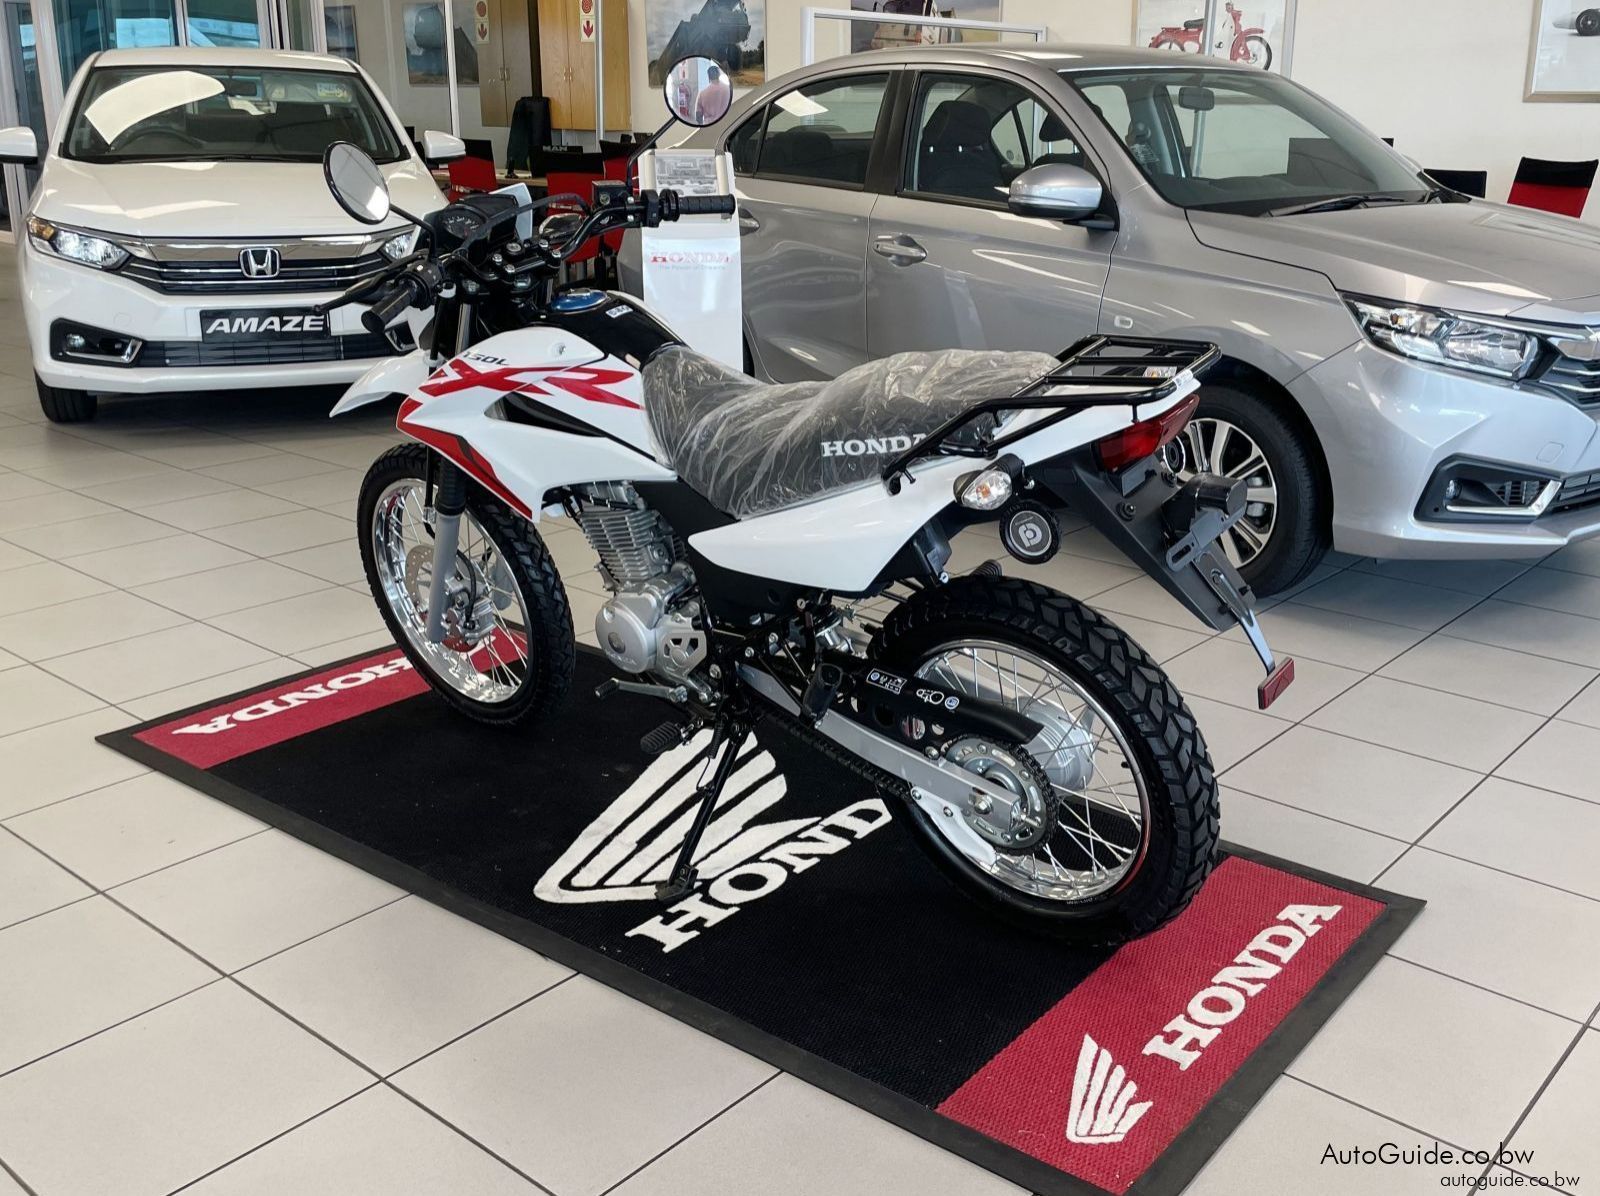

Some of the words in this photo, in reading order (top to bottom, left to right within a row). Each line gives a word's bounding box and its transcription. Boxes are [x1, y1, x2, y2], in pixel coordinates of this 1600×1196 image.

[650, 252, 733, 263] HONDA
[205, 315, 325, 334] AMAZE
[624, 798, 893, 953] HOND
[1141, 904, 1343, 1071] HONDA
